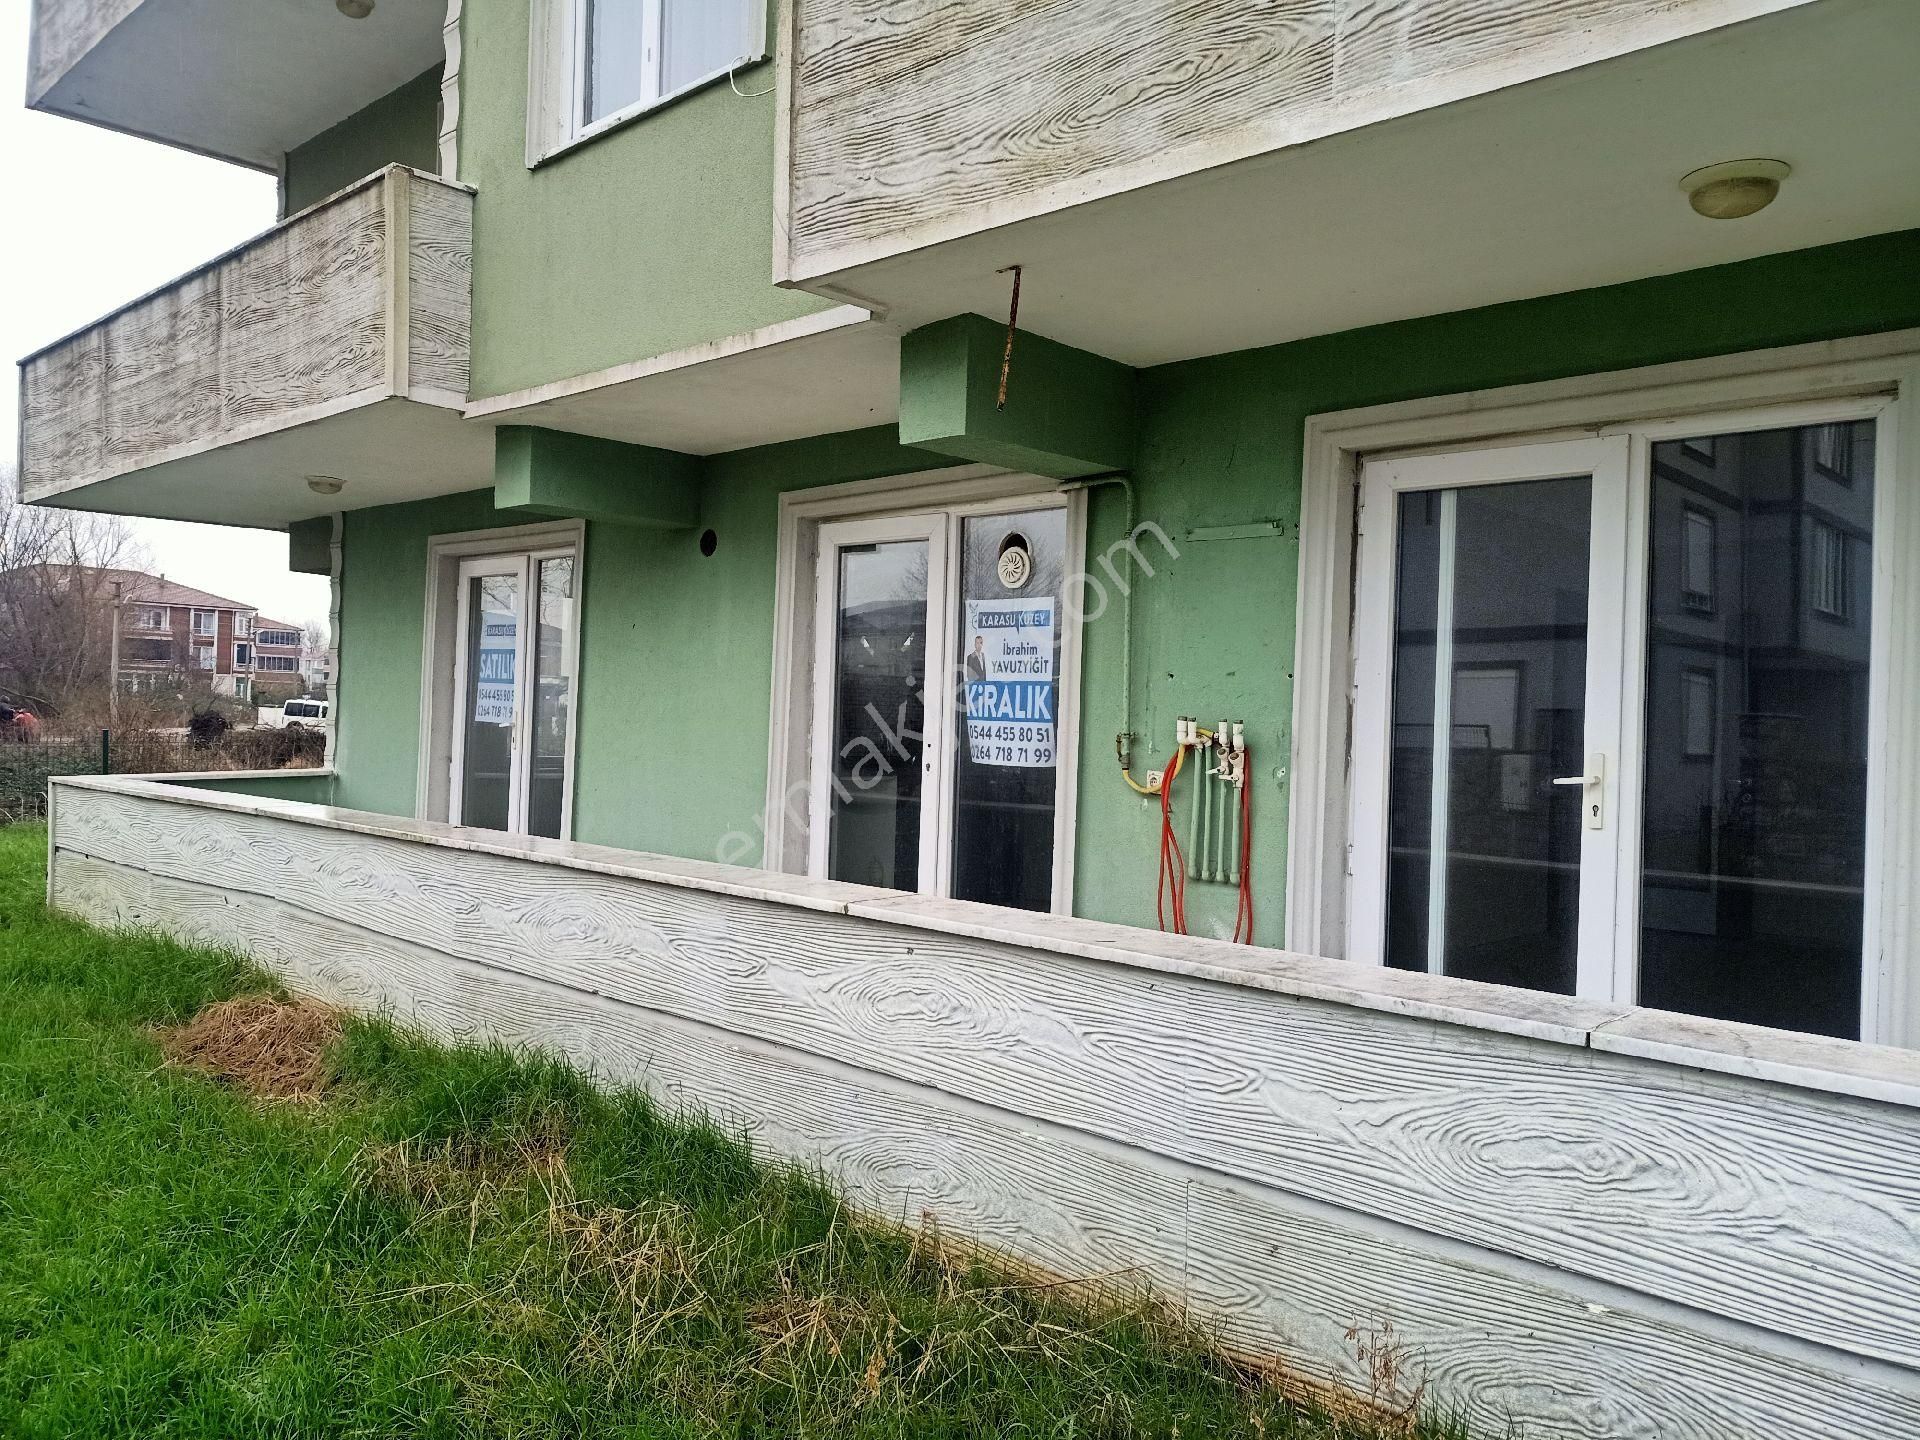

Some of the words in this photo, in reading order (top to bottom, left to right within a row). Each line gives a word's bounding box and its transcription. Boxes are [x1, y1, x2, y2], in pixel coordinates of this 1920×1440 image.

[982, 614, 1016, 627] KARASU
[1018, 610, 1046, 626] KUZEY
[1003, 638, 1038, 656] İbrahim
[992, 656, 1049, 674] YAVUZYİĞİT
[969, 725, 993, 741] 0544
[994, 726, 1016, 742] 455
[1018, 727, 1033, 743] 80
[1036, 727, 1050, 743] 51
[995, 746, 1013, 762] 718
[1017, 747, 1028, 763] 71
[1034, 748, 1052, 763] 99
